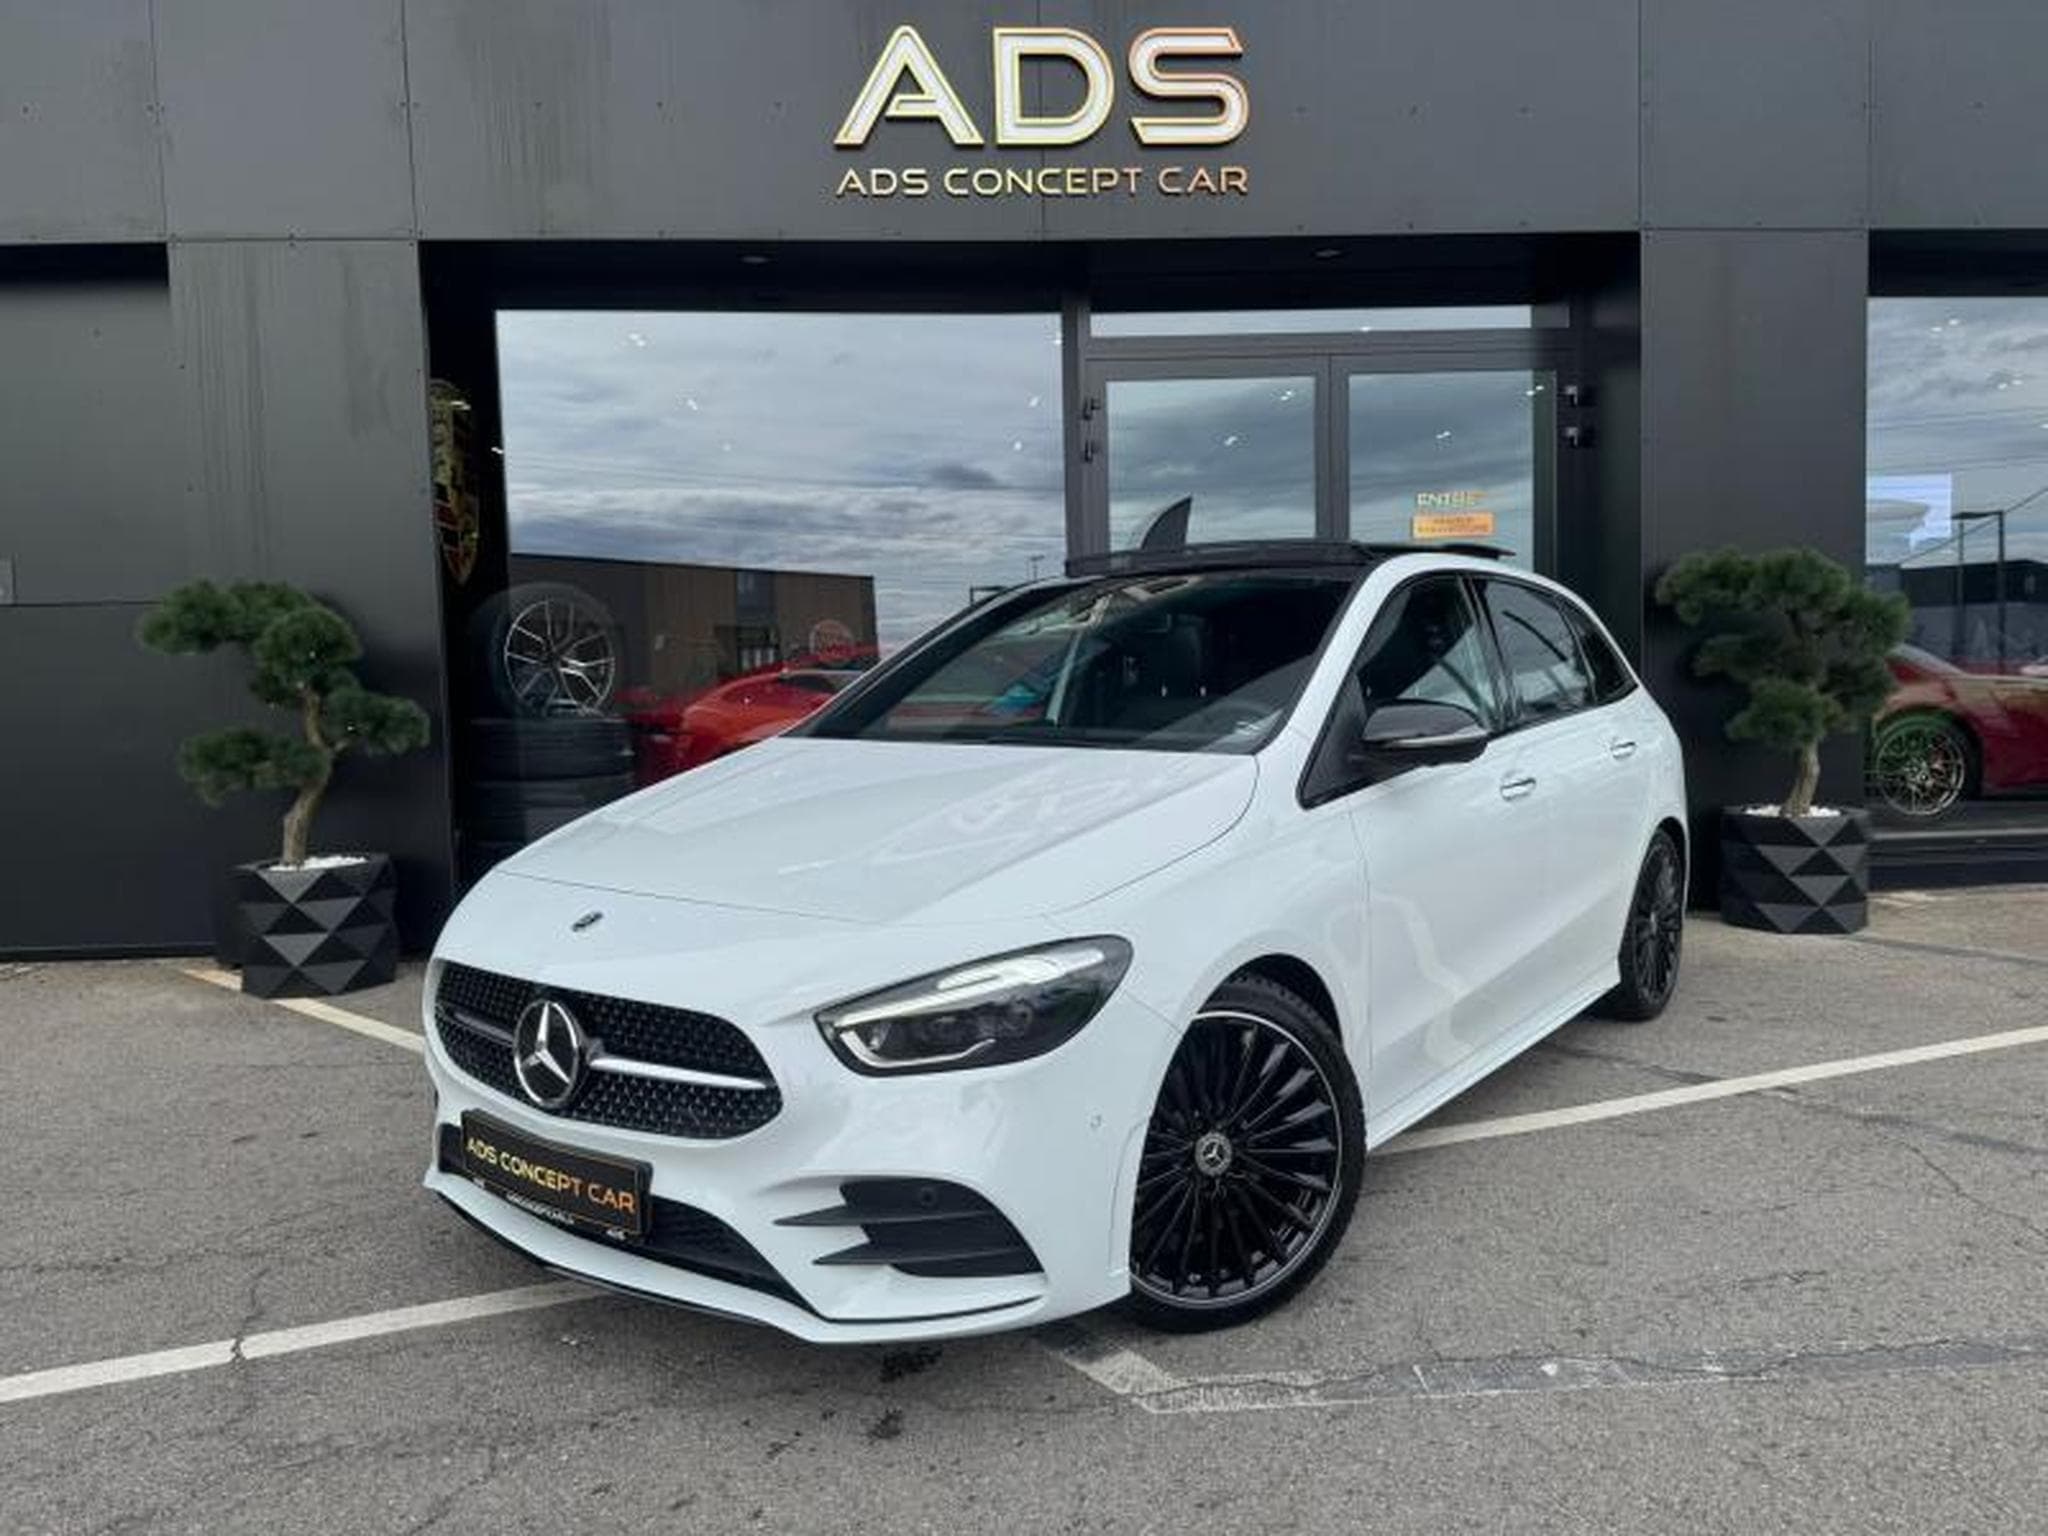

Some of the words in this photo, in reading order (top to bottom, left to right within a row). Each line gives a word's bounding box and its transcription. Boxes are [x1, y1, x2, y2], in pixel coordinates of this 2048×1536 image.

[834, 25, 1250, 146] ADS
[836, 168, 929, 196] ADS
[944, 167, 1143, 196] CONCEPT
[1158, 166, 1248, 194] CAR
[466, 1137, 498, 1165] ADS
[499, 1151, 582, 1198] CONCEPT
[588, 1183, 635, 1214] CAR
